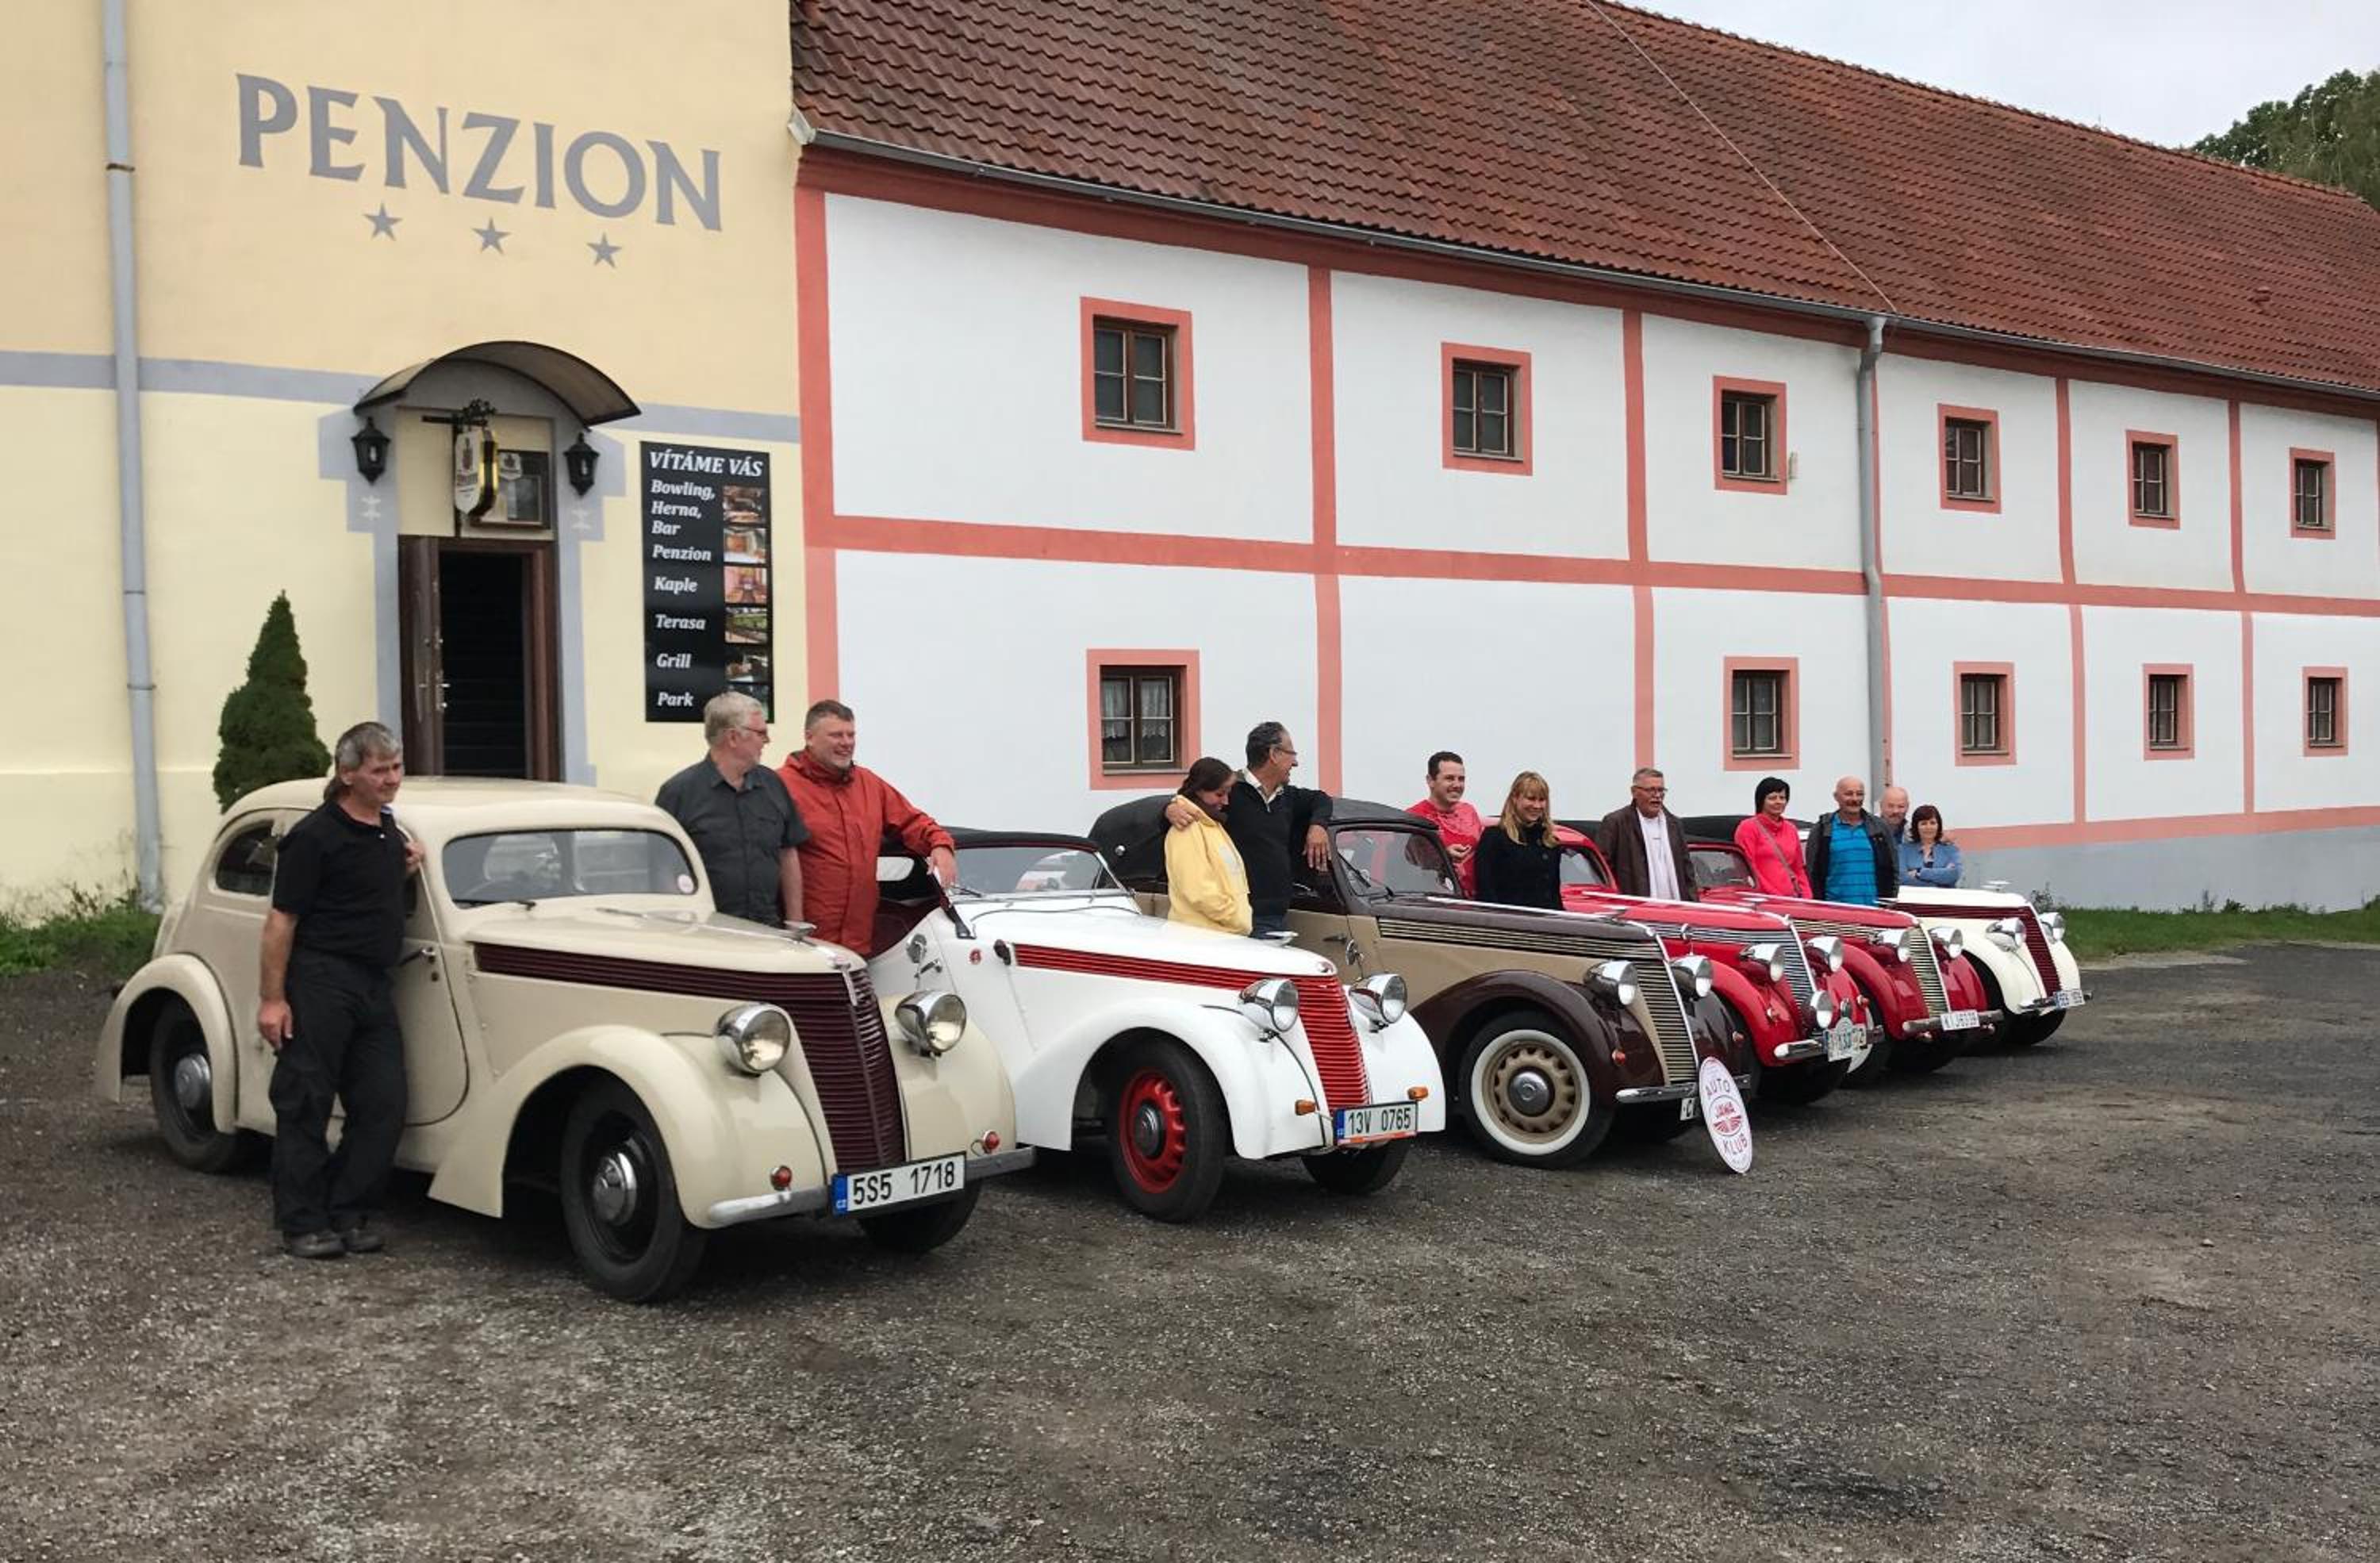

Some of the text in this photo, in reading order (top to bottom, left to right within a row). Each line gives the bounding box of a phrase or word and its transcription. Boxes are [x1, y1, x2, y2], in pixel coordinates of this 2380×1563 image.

[236, 73, 723, 232] PENZION
[650, 449, 763, 476] VÍTÁME VÁS
[651, 479, 716, 500] Bowling,
[651, 501, 702, 518] Herna,
[652, 520, 681, 536] Bar
[652, 545, 712, 562] Penzion
[654, 577, 698, 595] Kaple
[655, 614, 706, 630] Terasa
[657, 653, 691, 669] Grill
[658, 693, 694, 707] Park
[1706, 1078, 1730, 1096] AUTO
[1349, 1108, 1411, 1135] 13V 0765
[1723, 1135, 1748, 1154] KLUB
[853, 1161, 955, 1205] 5S5 1718
